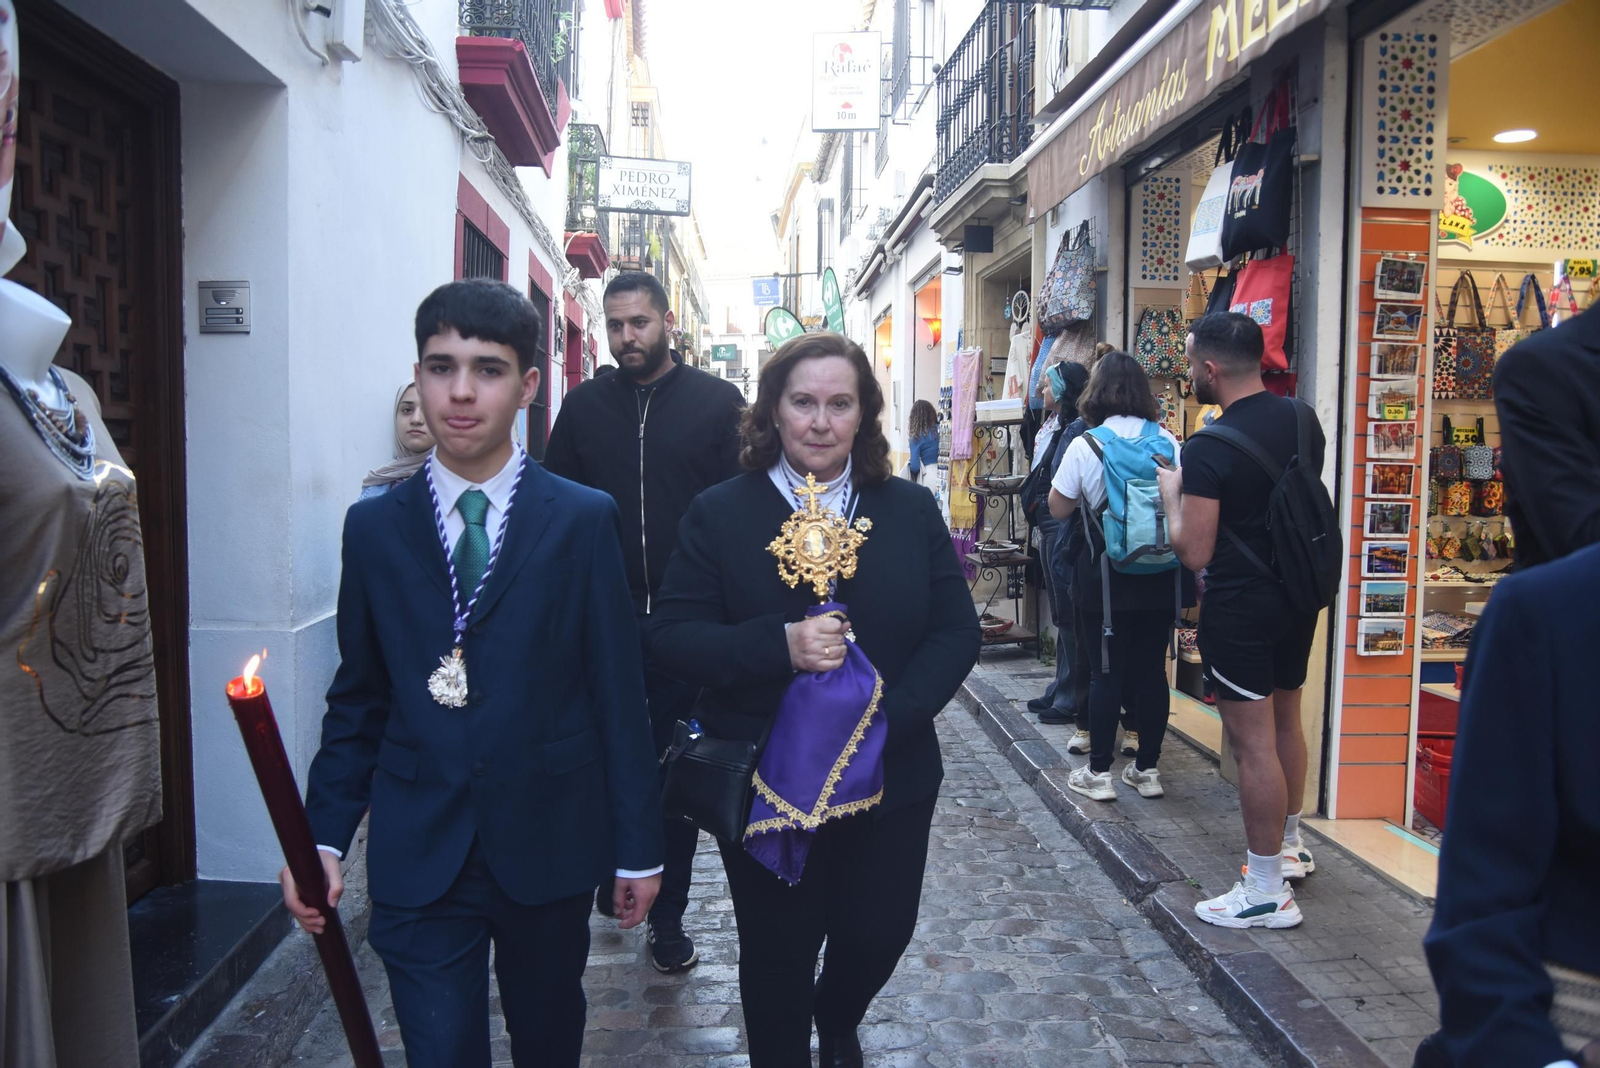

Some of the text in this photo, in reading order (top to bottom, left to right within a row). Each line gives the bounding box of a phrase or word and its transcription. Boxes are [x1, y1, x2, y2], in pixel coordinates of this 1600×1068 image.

[824, 59, 871, 77] Rafaé
[1079, 0, 1311, 176] Artesanías MEL
[620, 170, 670, 185] PEDRO
[612, 184, 677, 199] XIMÉNEZ
[1568, 266, 1592, 276] 7,95
[1454, 434, 1478, 444] 2,50
